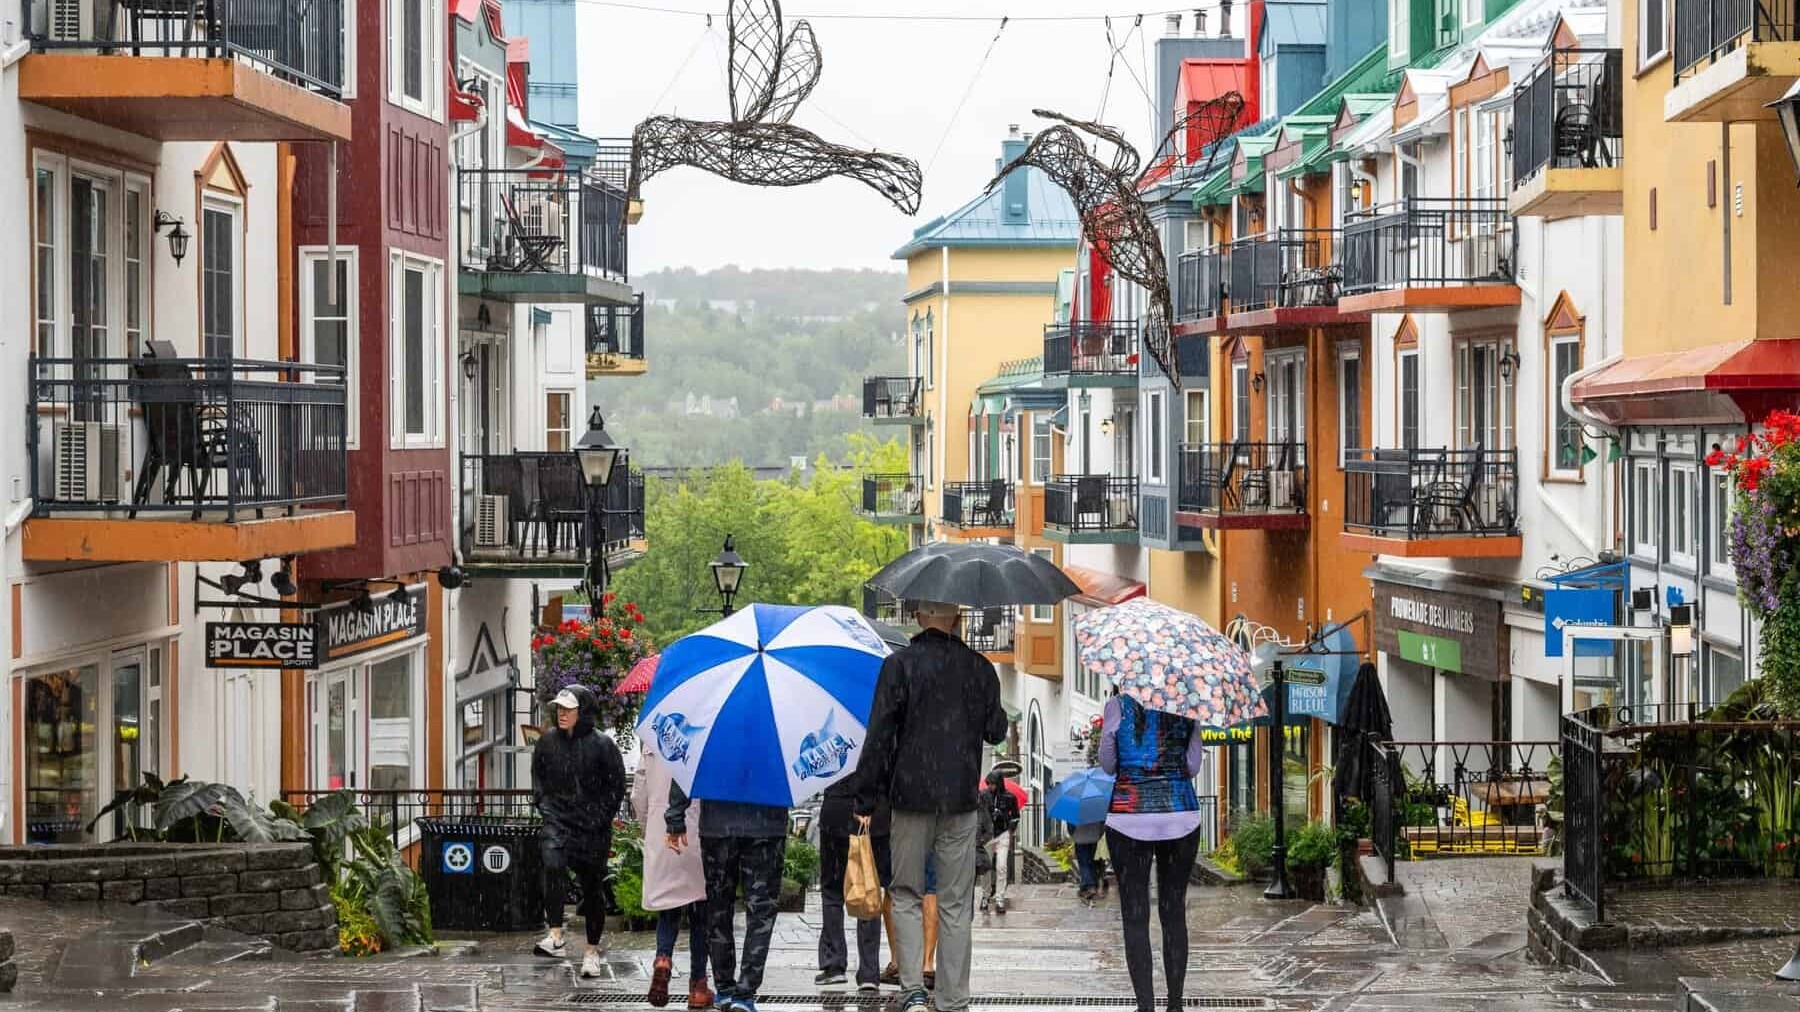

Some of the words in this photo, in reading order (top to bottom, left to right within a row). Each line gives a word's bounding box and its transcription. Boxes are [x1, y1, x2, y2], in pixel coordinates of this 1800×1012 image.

[1391, 596, 1428, 625] PROMENADE
[328, 605, 381, 647] MAGASIN
[383, 596, 417, 633] PLACE
[214, 626, 314, 640] MAGASIN
[214, 640, 314, 659] PLACE
[1291, 698, 1329, 713] BLEUE
[1229, 726, 1253, 740] Thé
